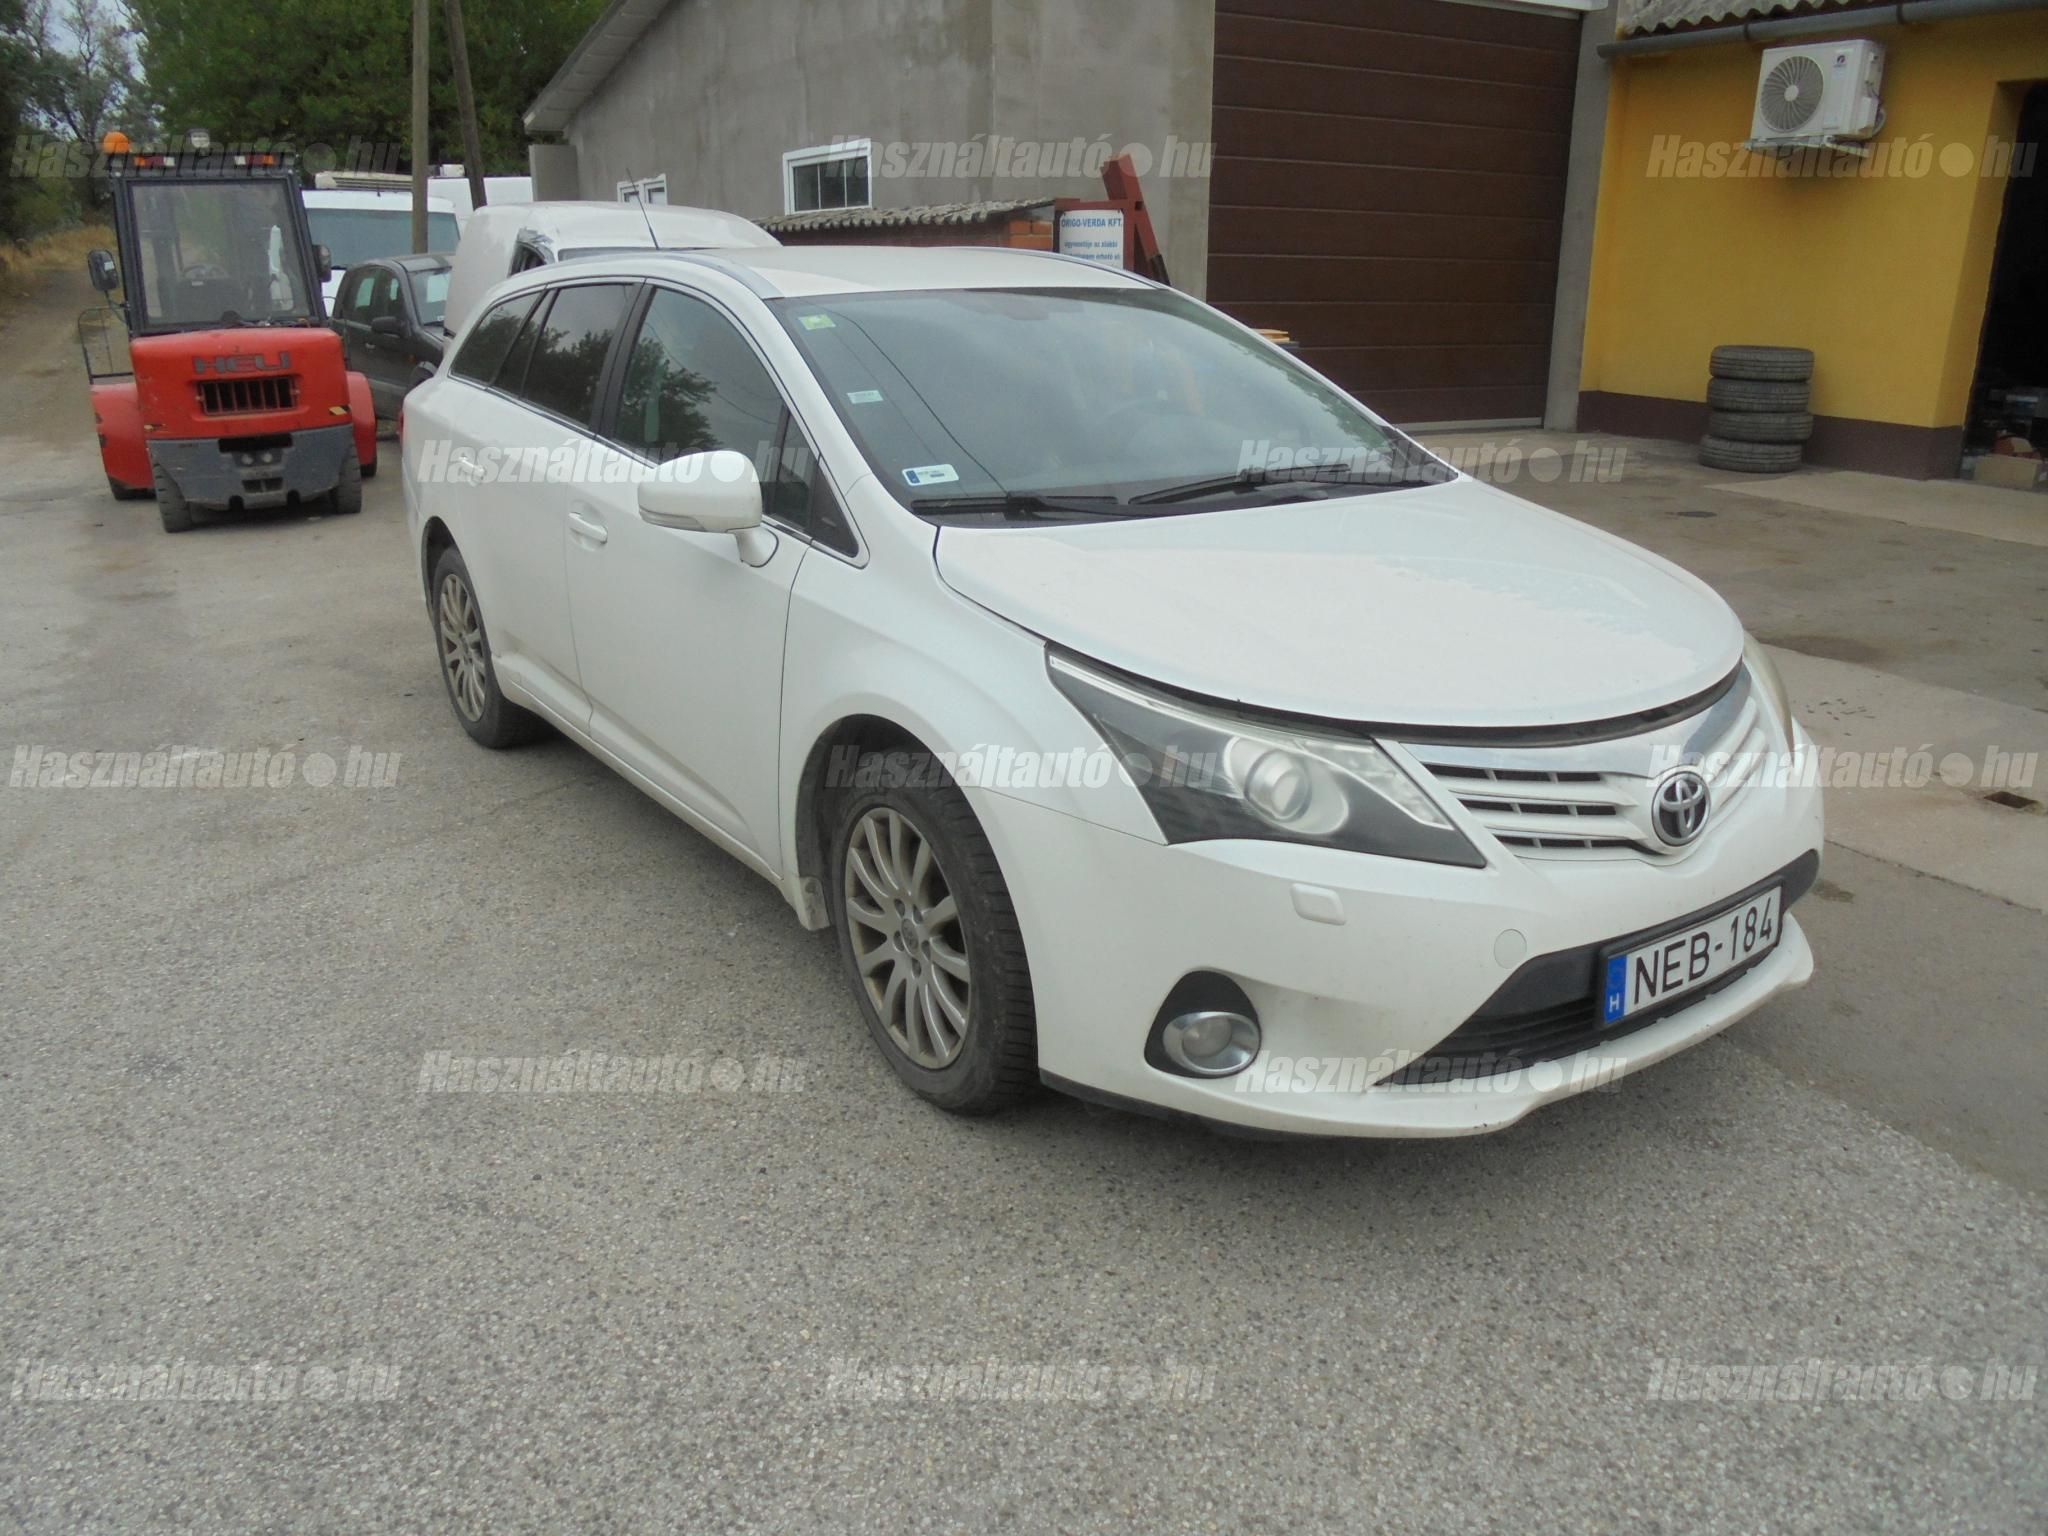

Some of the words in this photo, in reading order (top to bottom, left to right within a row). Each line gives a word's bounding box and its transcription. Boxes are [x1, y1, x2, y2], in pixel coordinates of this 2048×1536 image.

[193, 351, 292, 374] HELI
[1608, 993, 1620, 1013] H
[1634, 896, 1772, 1005] NEB-184
